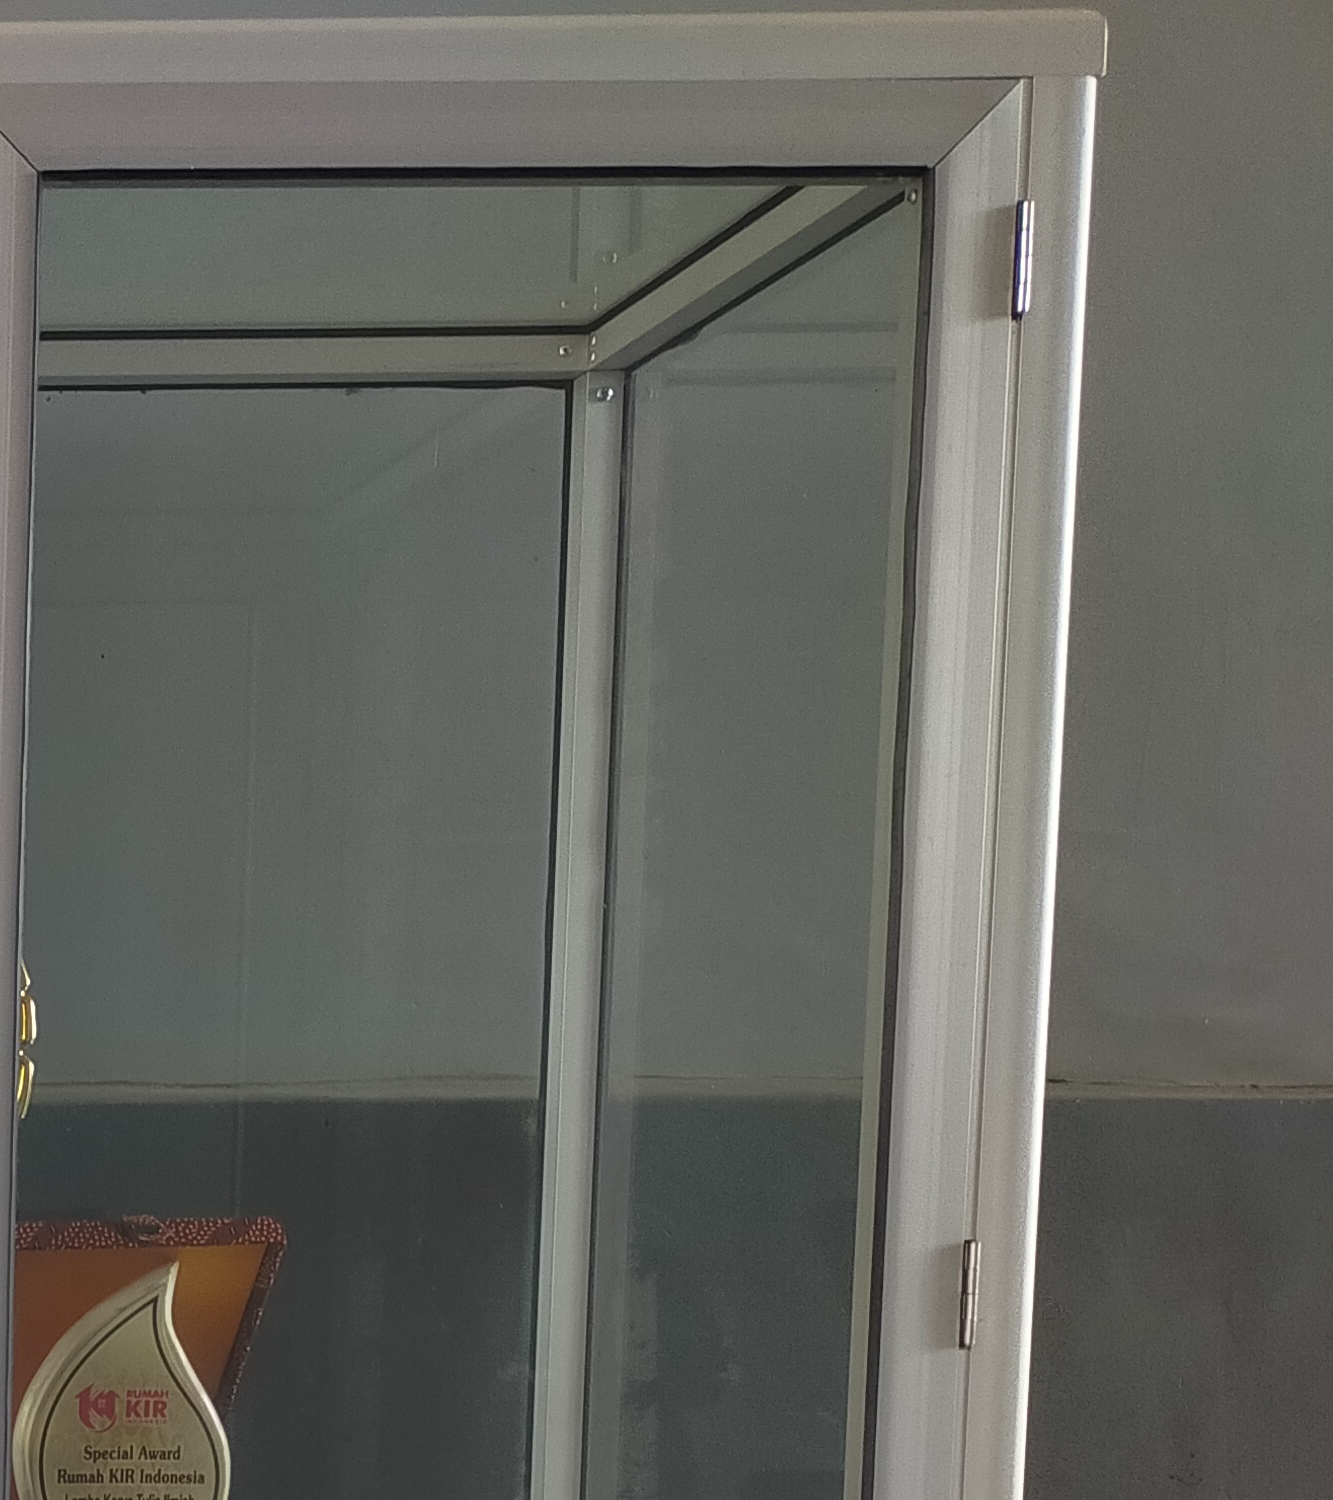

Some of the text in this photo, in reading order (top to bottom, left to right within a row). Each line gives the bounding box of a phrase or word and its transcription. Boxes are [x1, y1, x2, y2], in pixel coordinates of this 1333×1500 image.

[126, 1389, 170, 1399] RUMAH
[126, 1400, 168, 1419] KIR
[83, 1445, 181, 1464] Special Award
[57, 1469, 205, 1485] Rumah KIR Indonesia
